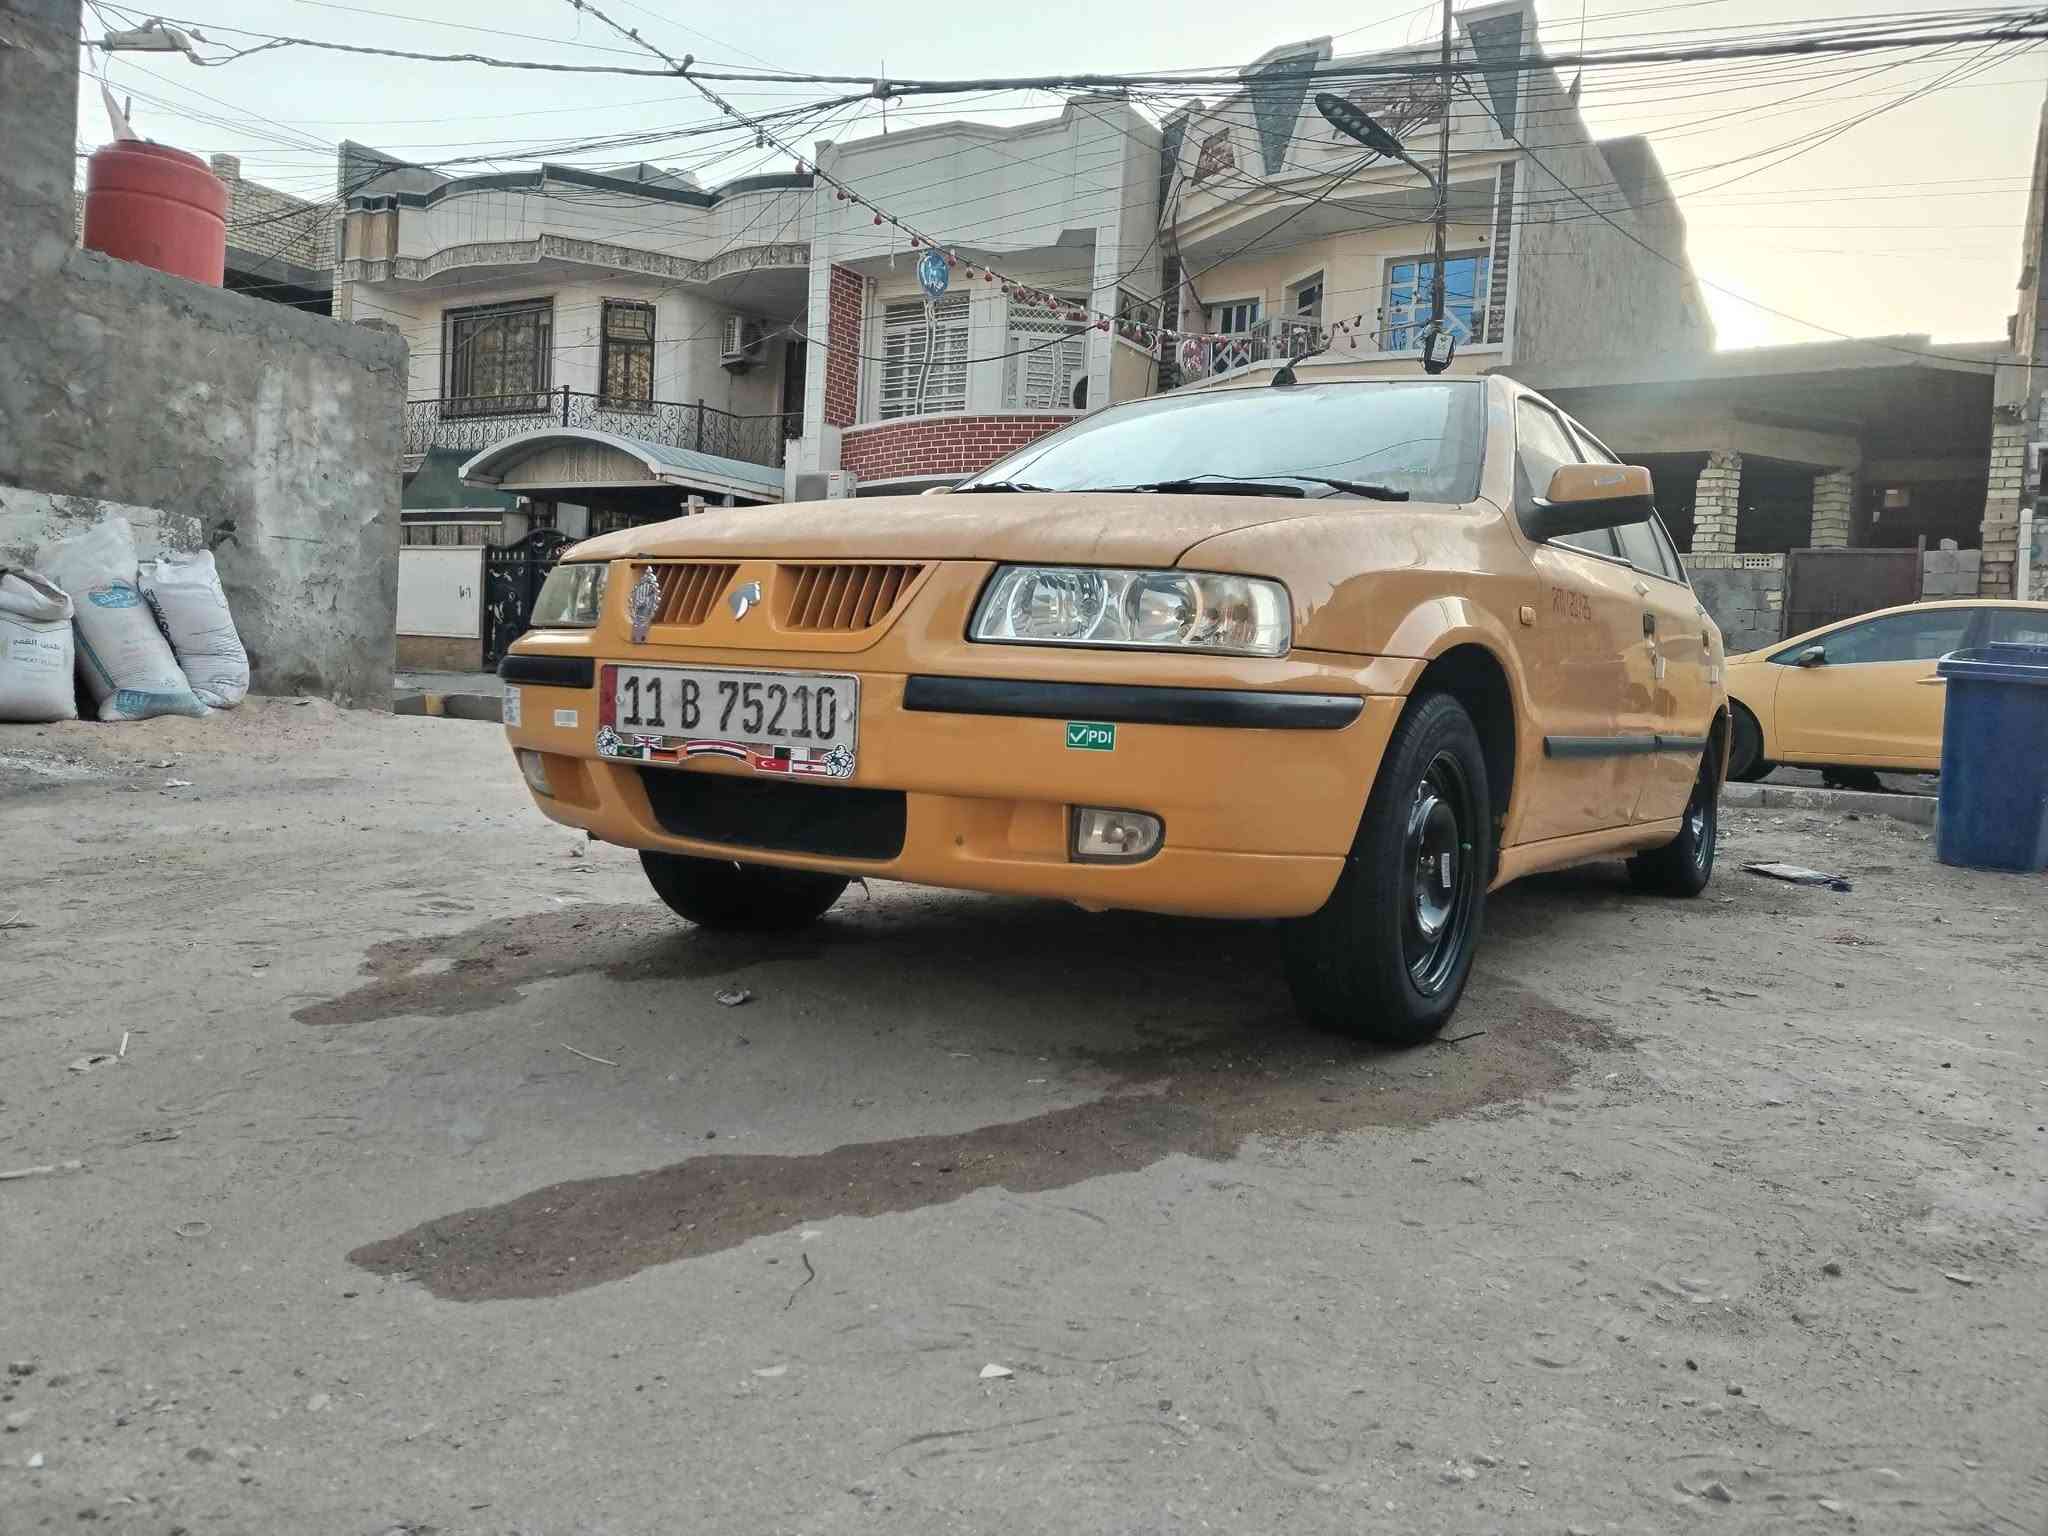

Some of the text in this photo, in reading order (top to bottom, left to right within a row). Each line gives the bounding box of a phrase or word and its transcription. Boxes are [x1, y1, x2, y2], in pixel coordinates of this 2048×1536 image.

[622, 675, 838, 740] 11 B 75210
[1088, 729, 1112, 744] PDI
